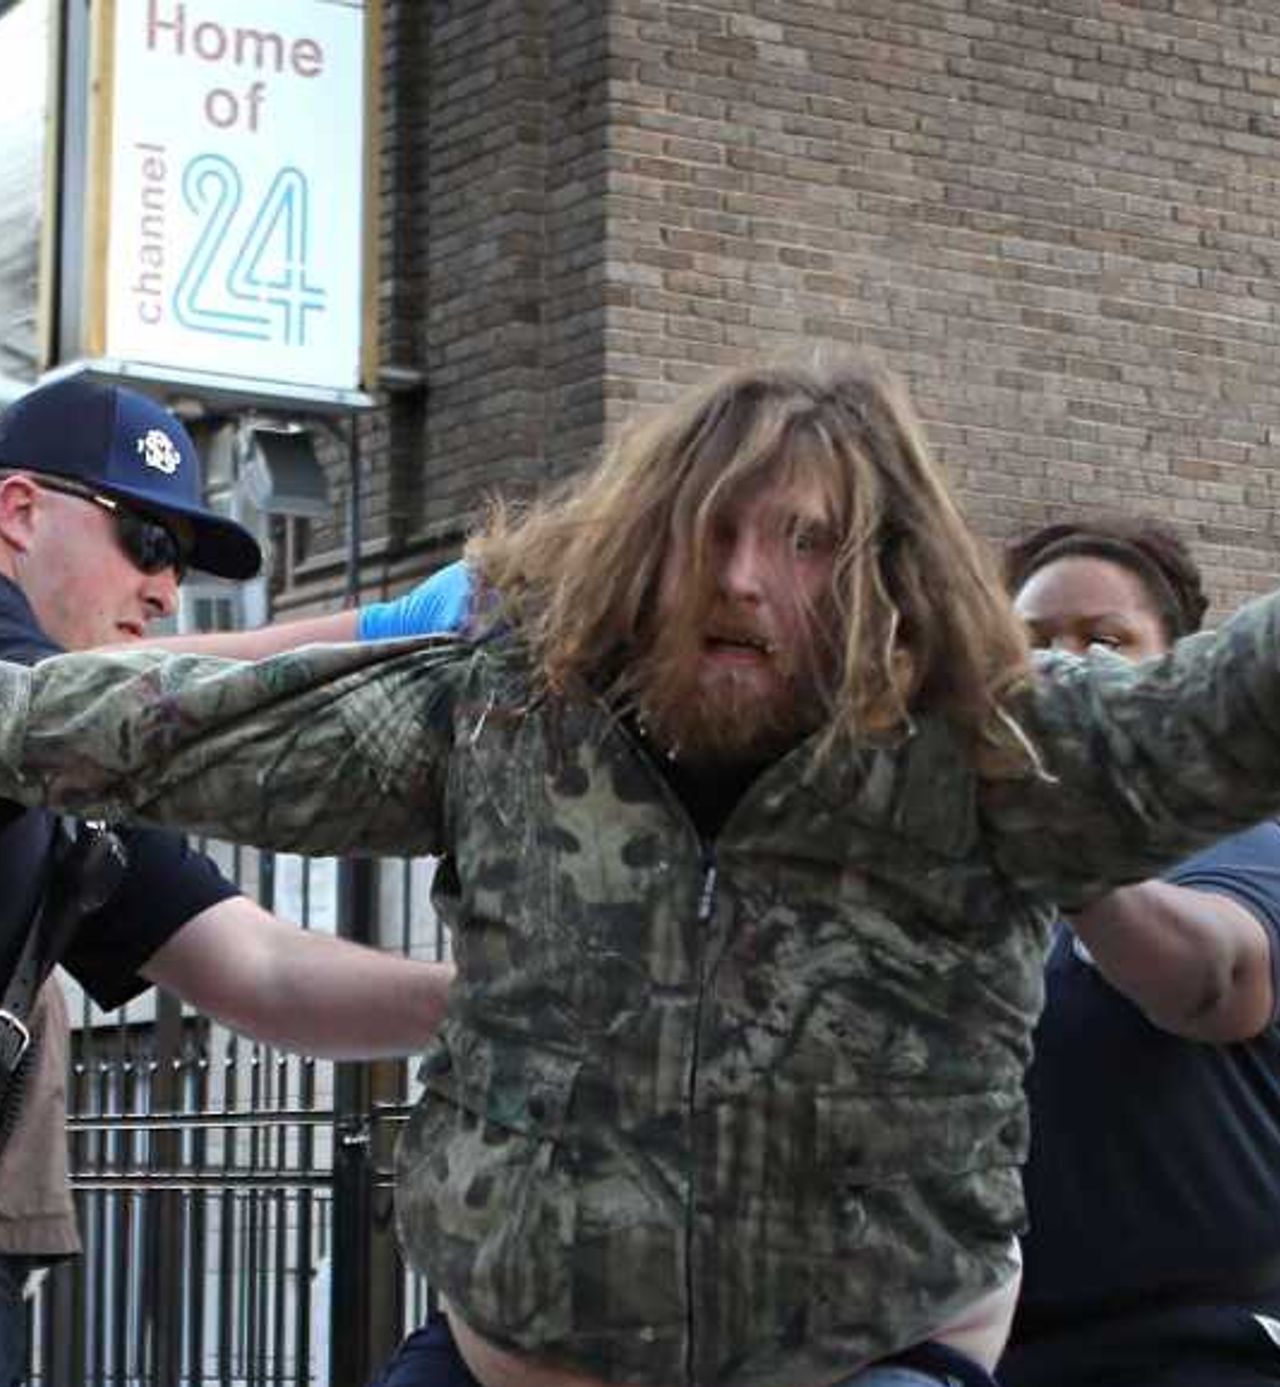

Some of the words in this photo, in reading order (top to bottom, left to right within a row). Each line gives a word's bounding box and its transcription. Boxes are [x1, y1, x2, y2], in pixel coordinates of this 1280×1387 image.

[146, 0, 324, 78] Home
[204, 81, 266, 132] of
[133, 142, 167, 325] channel
[172, 153, 327, 346] 24
